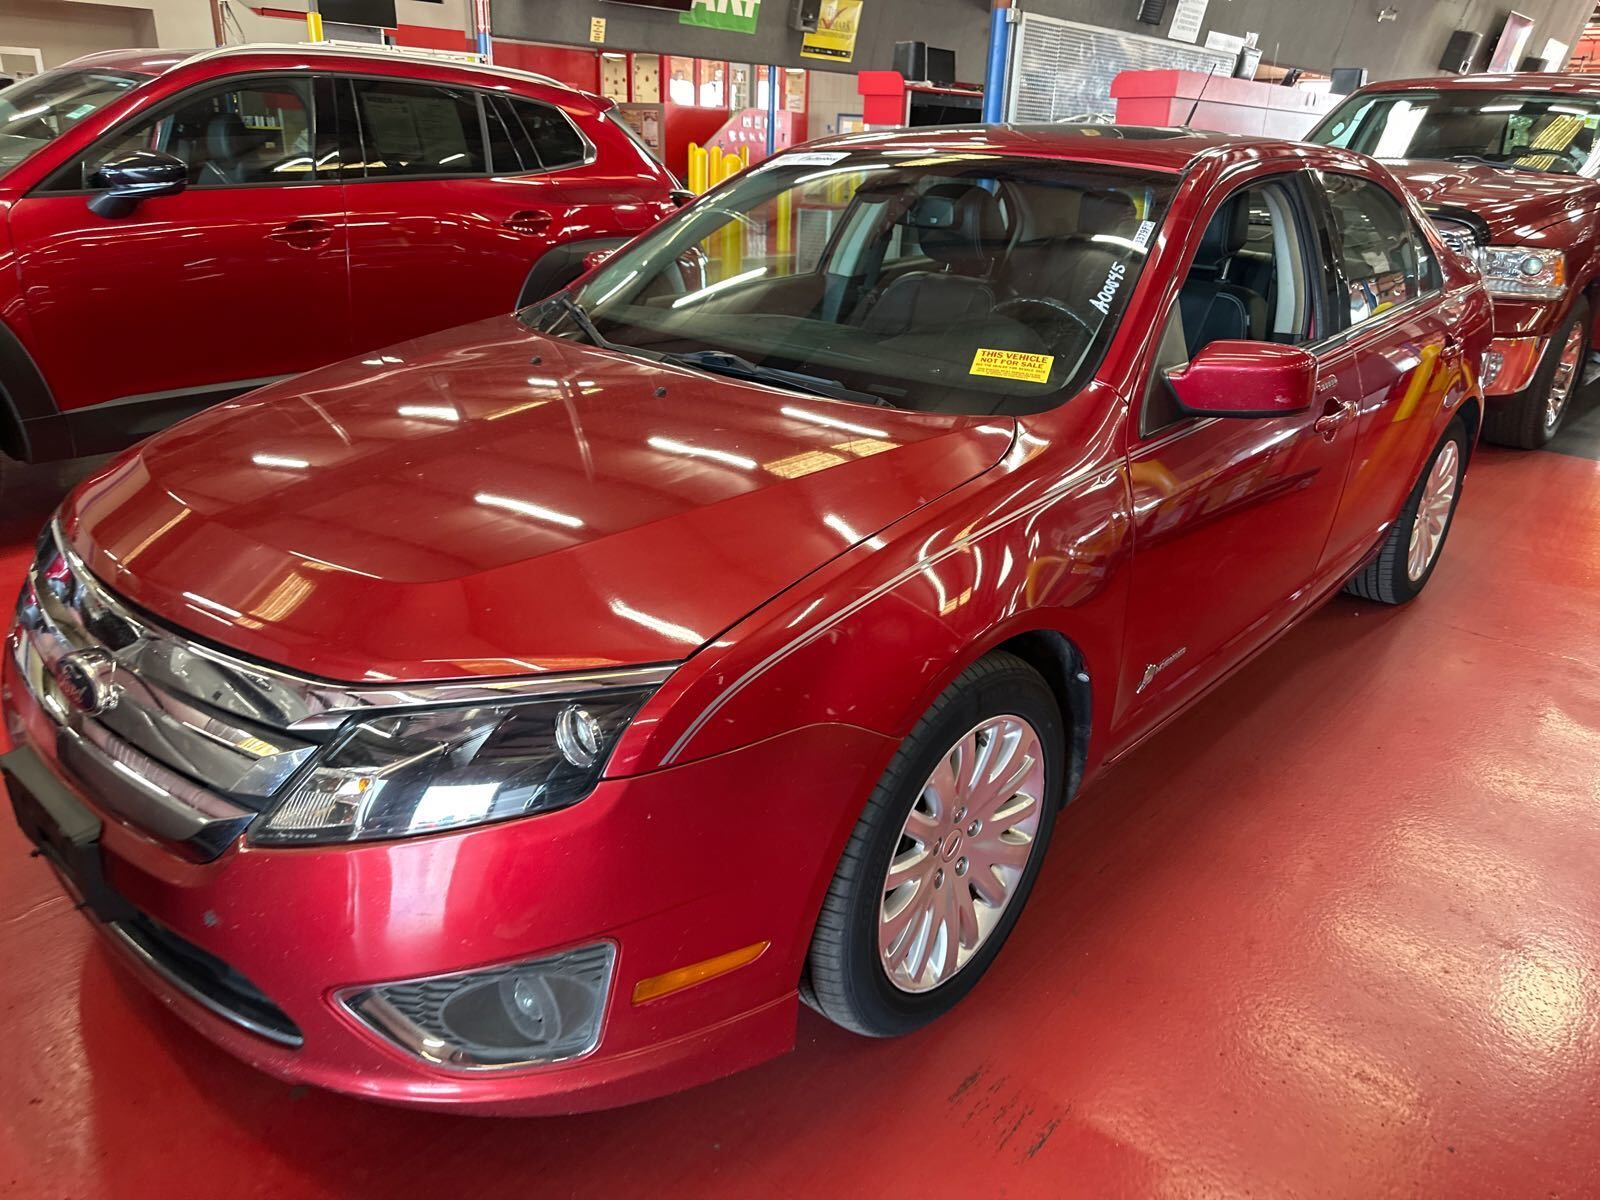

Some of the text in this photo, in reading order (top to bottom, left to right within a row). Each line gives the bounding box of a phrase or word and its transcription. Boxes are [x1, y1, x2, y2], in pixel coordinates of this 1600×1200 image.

[981, 350, 1049, 364] THIS VEHICLE
[1000, 359, 1019, 367] FOR
[1021, 361, 1044, 369] SALE
